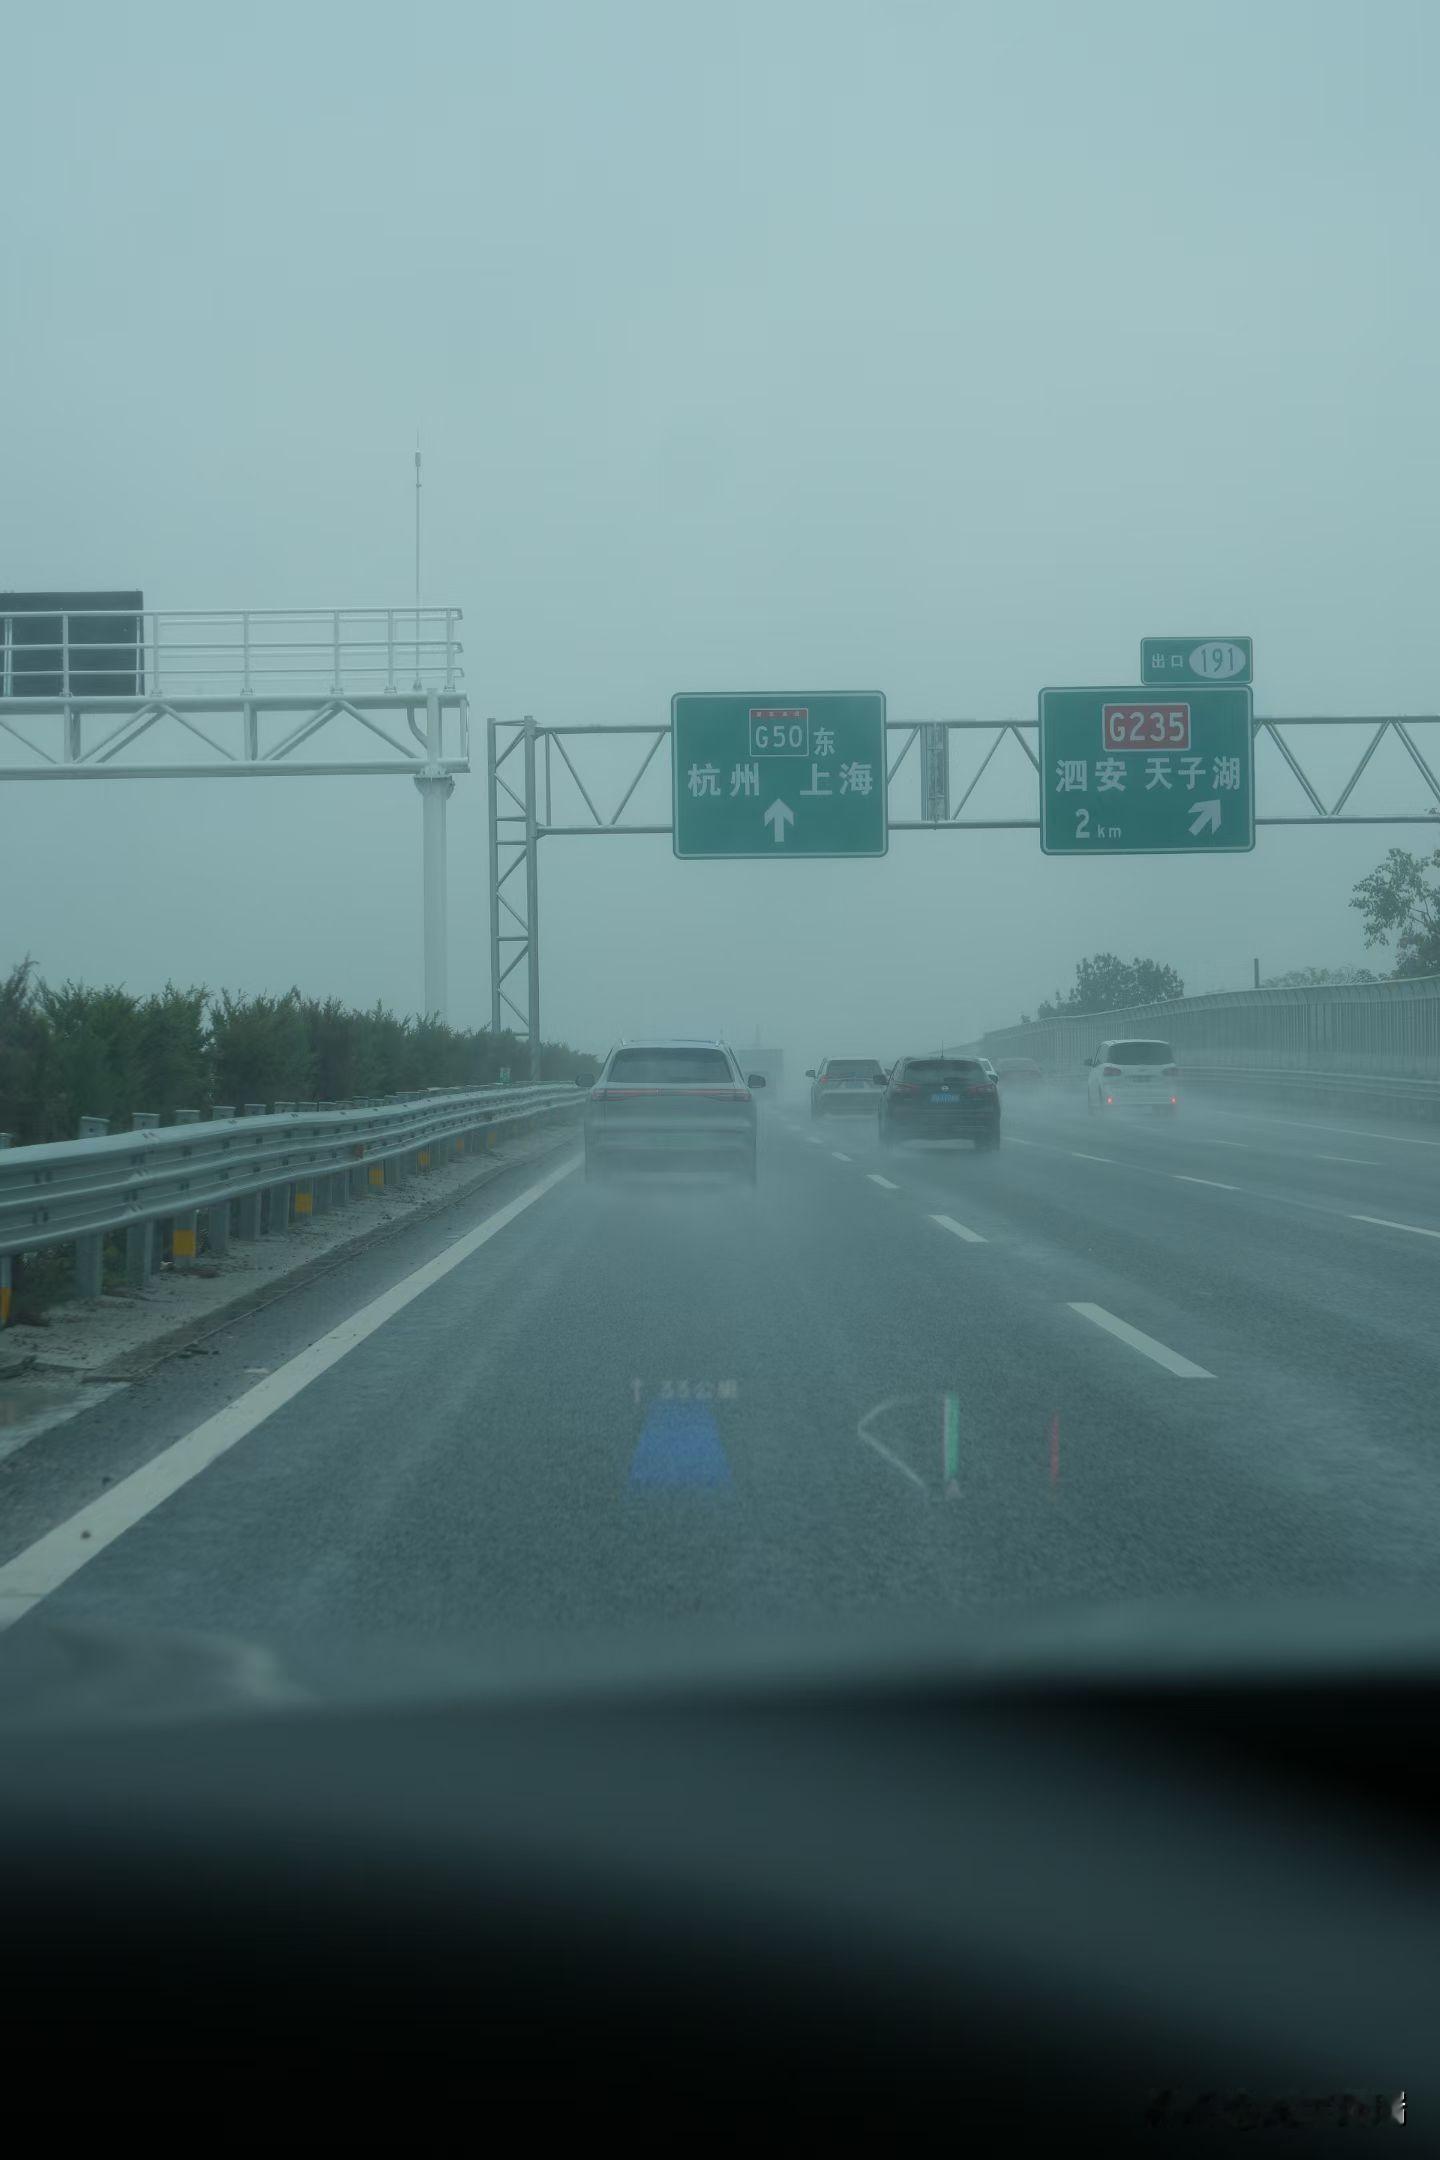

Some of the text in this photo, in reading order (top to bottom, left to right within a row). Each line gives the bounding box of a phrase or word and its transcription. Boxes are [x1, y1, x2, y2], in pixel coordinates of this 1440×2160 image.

[1152, 648, 1233, 672] 出口 191
[755, 725, 802, 748] G50
[813, 727, 835, 756] 东
[1109, 712, 1185, 742] G235
[687, 762, 873, 797] 杭州 上海
[1056, 756, 1240, 792] 泗安 天子湖
[1075, 809, 1122, 839] 2 km
